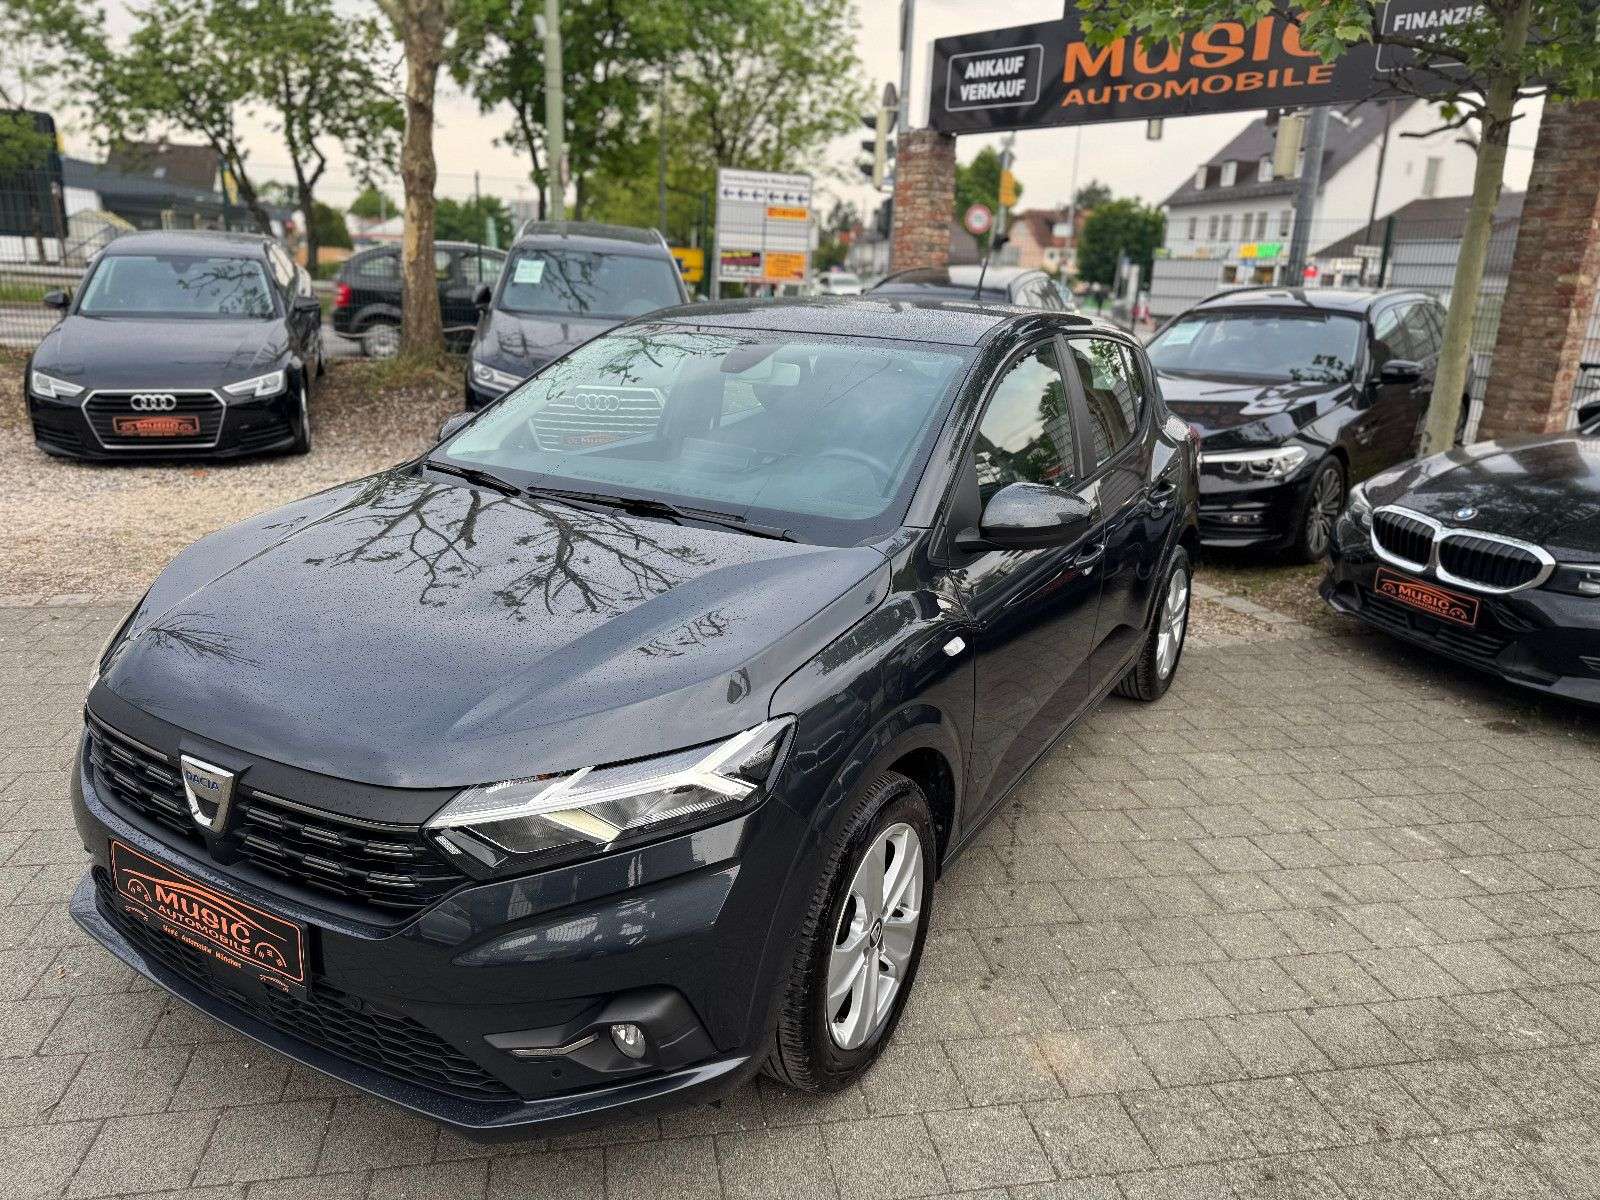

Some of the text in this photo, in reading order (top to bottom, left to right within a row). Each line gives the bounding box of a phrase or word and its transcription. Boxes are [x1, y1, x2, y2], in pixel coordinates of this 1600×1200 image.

[964, 56, 1025, 79] ANKAUF
[960, 79, 1027, 101] VERKAUF
[1061, 63, 1336, 107] AUTOMOBILE
[184, 769, 220, 791] DACIA
[158, 904, 251, 955] AUTOMOBILE
